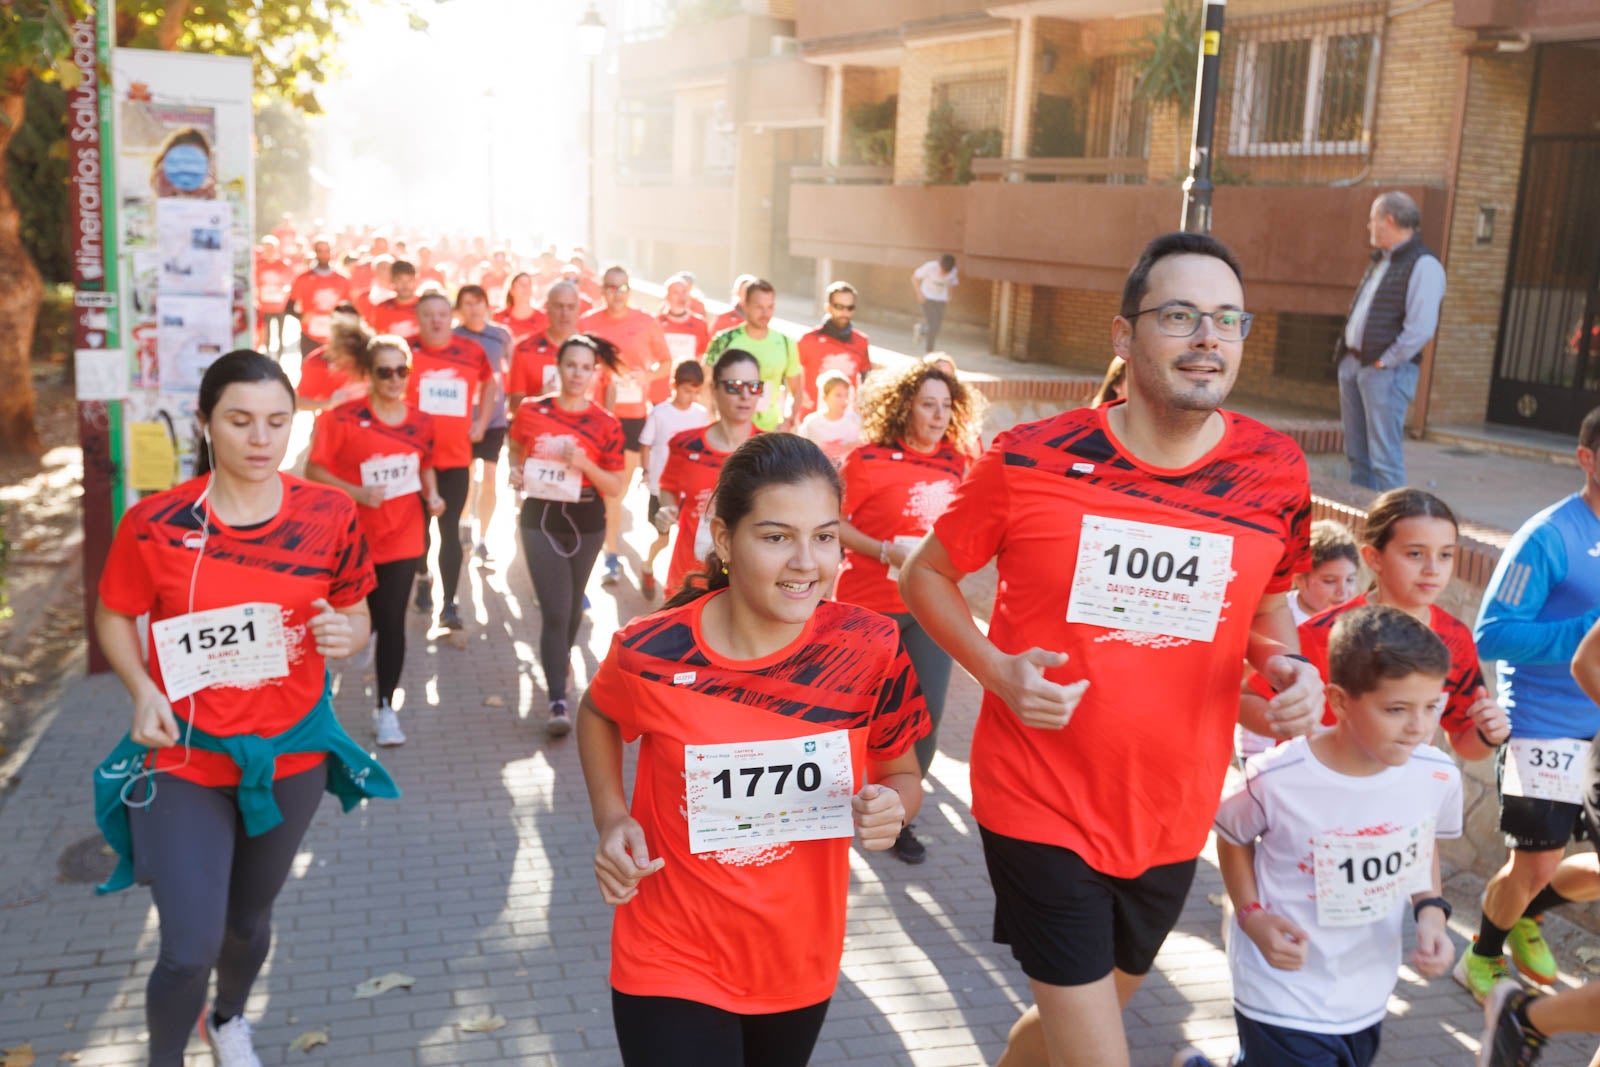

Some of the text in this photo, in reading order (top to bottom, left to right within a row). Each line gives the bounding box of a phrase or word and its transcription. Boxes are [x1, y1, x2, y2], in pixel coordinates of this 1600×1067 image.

[372, 466, 408, 482] 1787
[538, 469, 566, 482] 718
[1104, 544, 1200, 587] 1004
[1106, 583, 1136, 596] DAVID
[1139, 588, 1170, 601] PEREZ
[178, 620, 257, 654] 1521
[1528, 747, 1575, 771] 337
[712, 761, 822, 800] 1770
[1338, 842, 1418, 885] 1003
